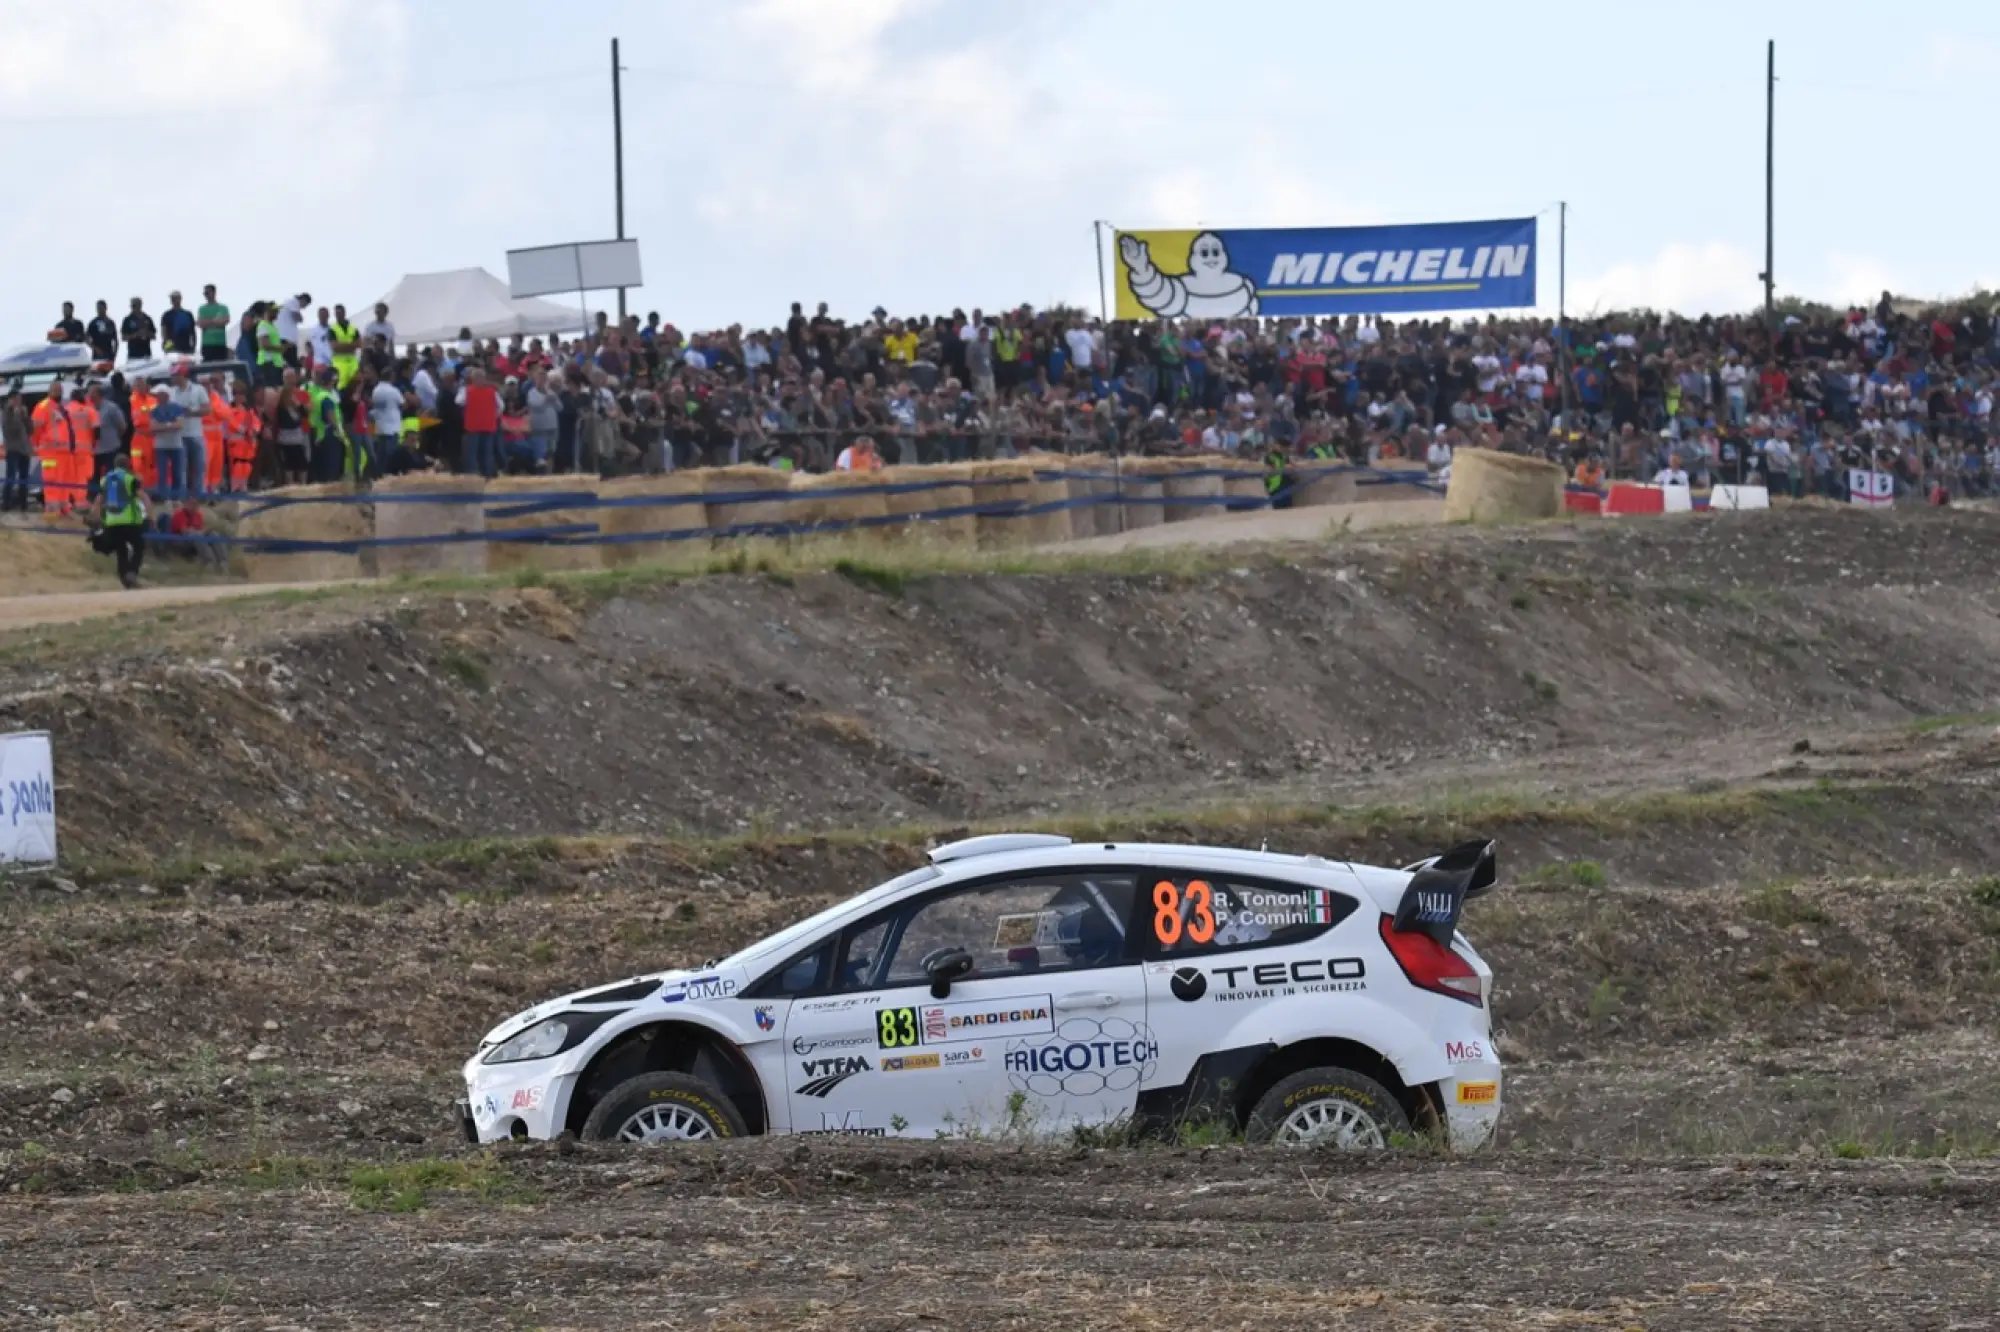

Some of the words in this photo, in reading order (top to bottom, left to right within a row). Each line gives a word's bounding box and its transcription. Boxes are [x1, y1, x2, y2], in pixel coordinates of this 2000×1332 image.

[1267, 245, 1529, 285] MICHELIN
[1153, 880, 1215, 944] 83
[1213, 891, 1234, 907] R.
[1238, 890, 1308, 908] Tononi
[1417, 891, 1453, 913] VALLI
[1214, 911, 1235, 926] P.
[1239, 910, 1309, 926] Comini
[1212, 957, 1365, 989] TECO
[1214, 988, 1275, 1002] INNOVARE
[1283, 987, 1296, 996] IN
[1302, 981, 1368, 993] SICUREZZA
[881, 1008, 915, 1047] 83
[925, 1008, 947, 1039] 2016
[950, 1008, 1048, 1027] SARDEGNA
[944, 1051, 970, 1061] sara
[1004, 1040, 1159, 1072] FRIGOTECH
